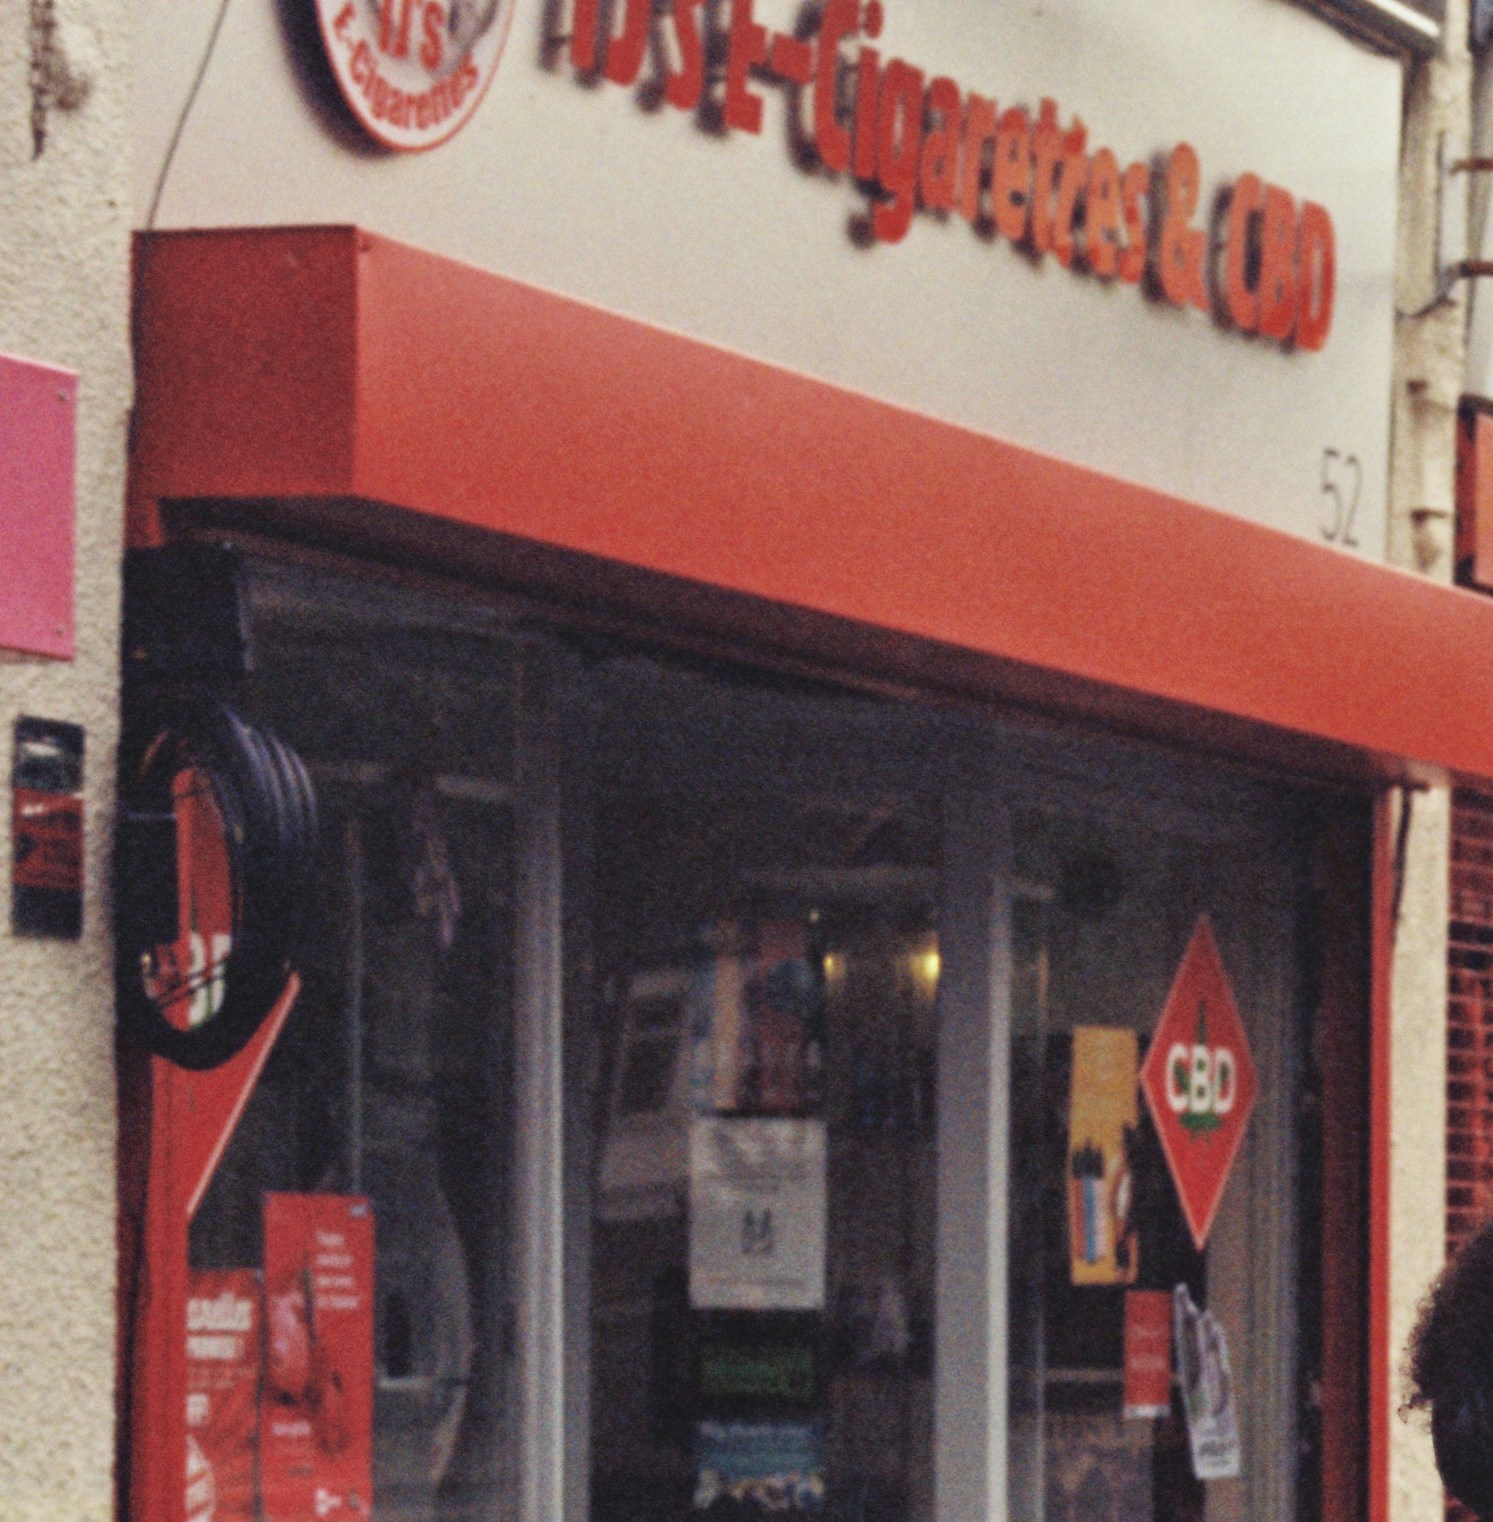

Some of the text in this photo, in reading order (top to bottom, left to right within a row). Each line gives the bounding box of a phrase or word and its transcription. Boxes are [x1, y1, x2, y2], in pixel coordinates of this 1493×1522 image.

[1158, 142, 1210, 312] &
[1225, 170, 1337, 353] CBD
[1320, 447, 1362, 548] 52
[1165, 1042, 1237, 1115] CBD
